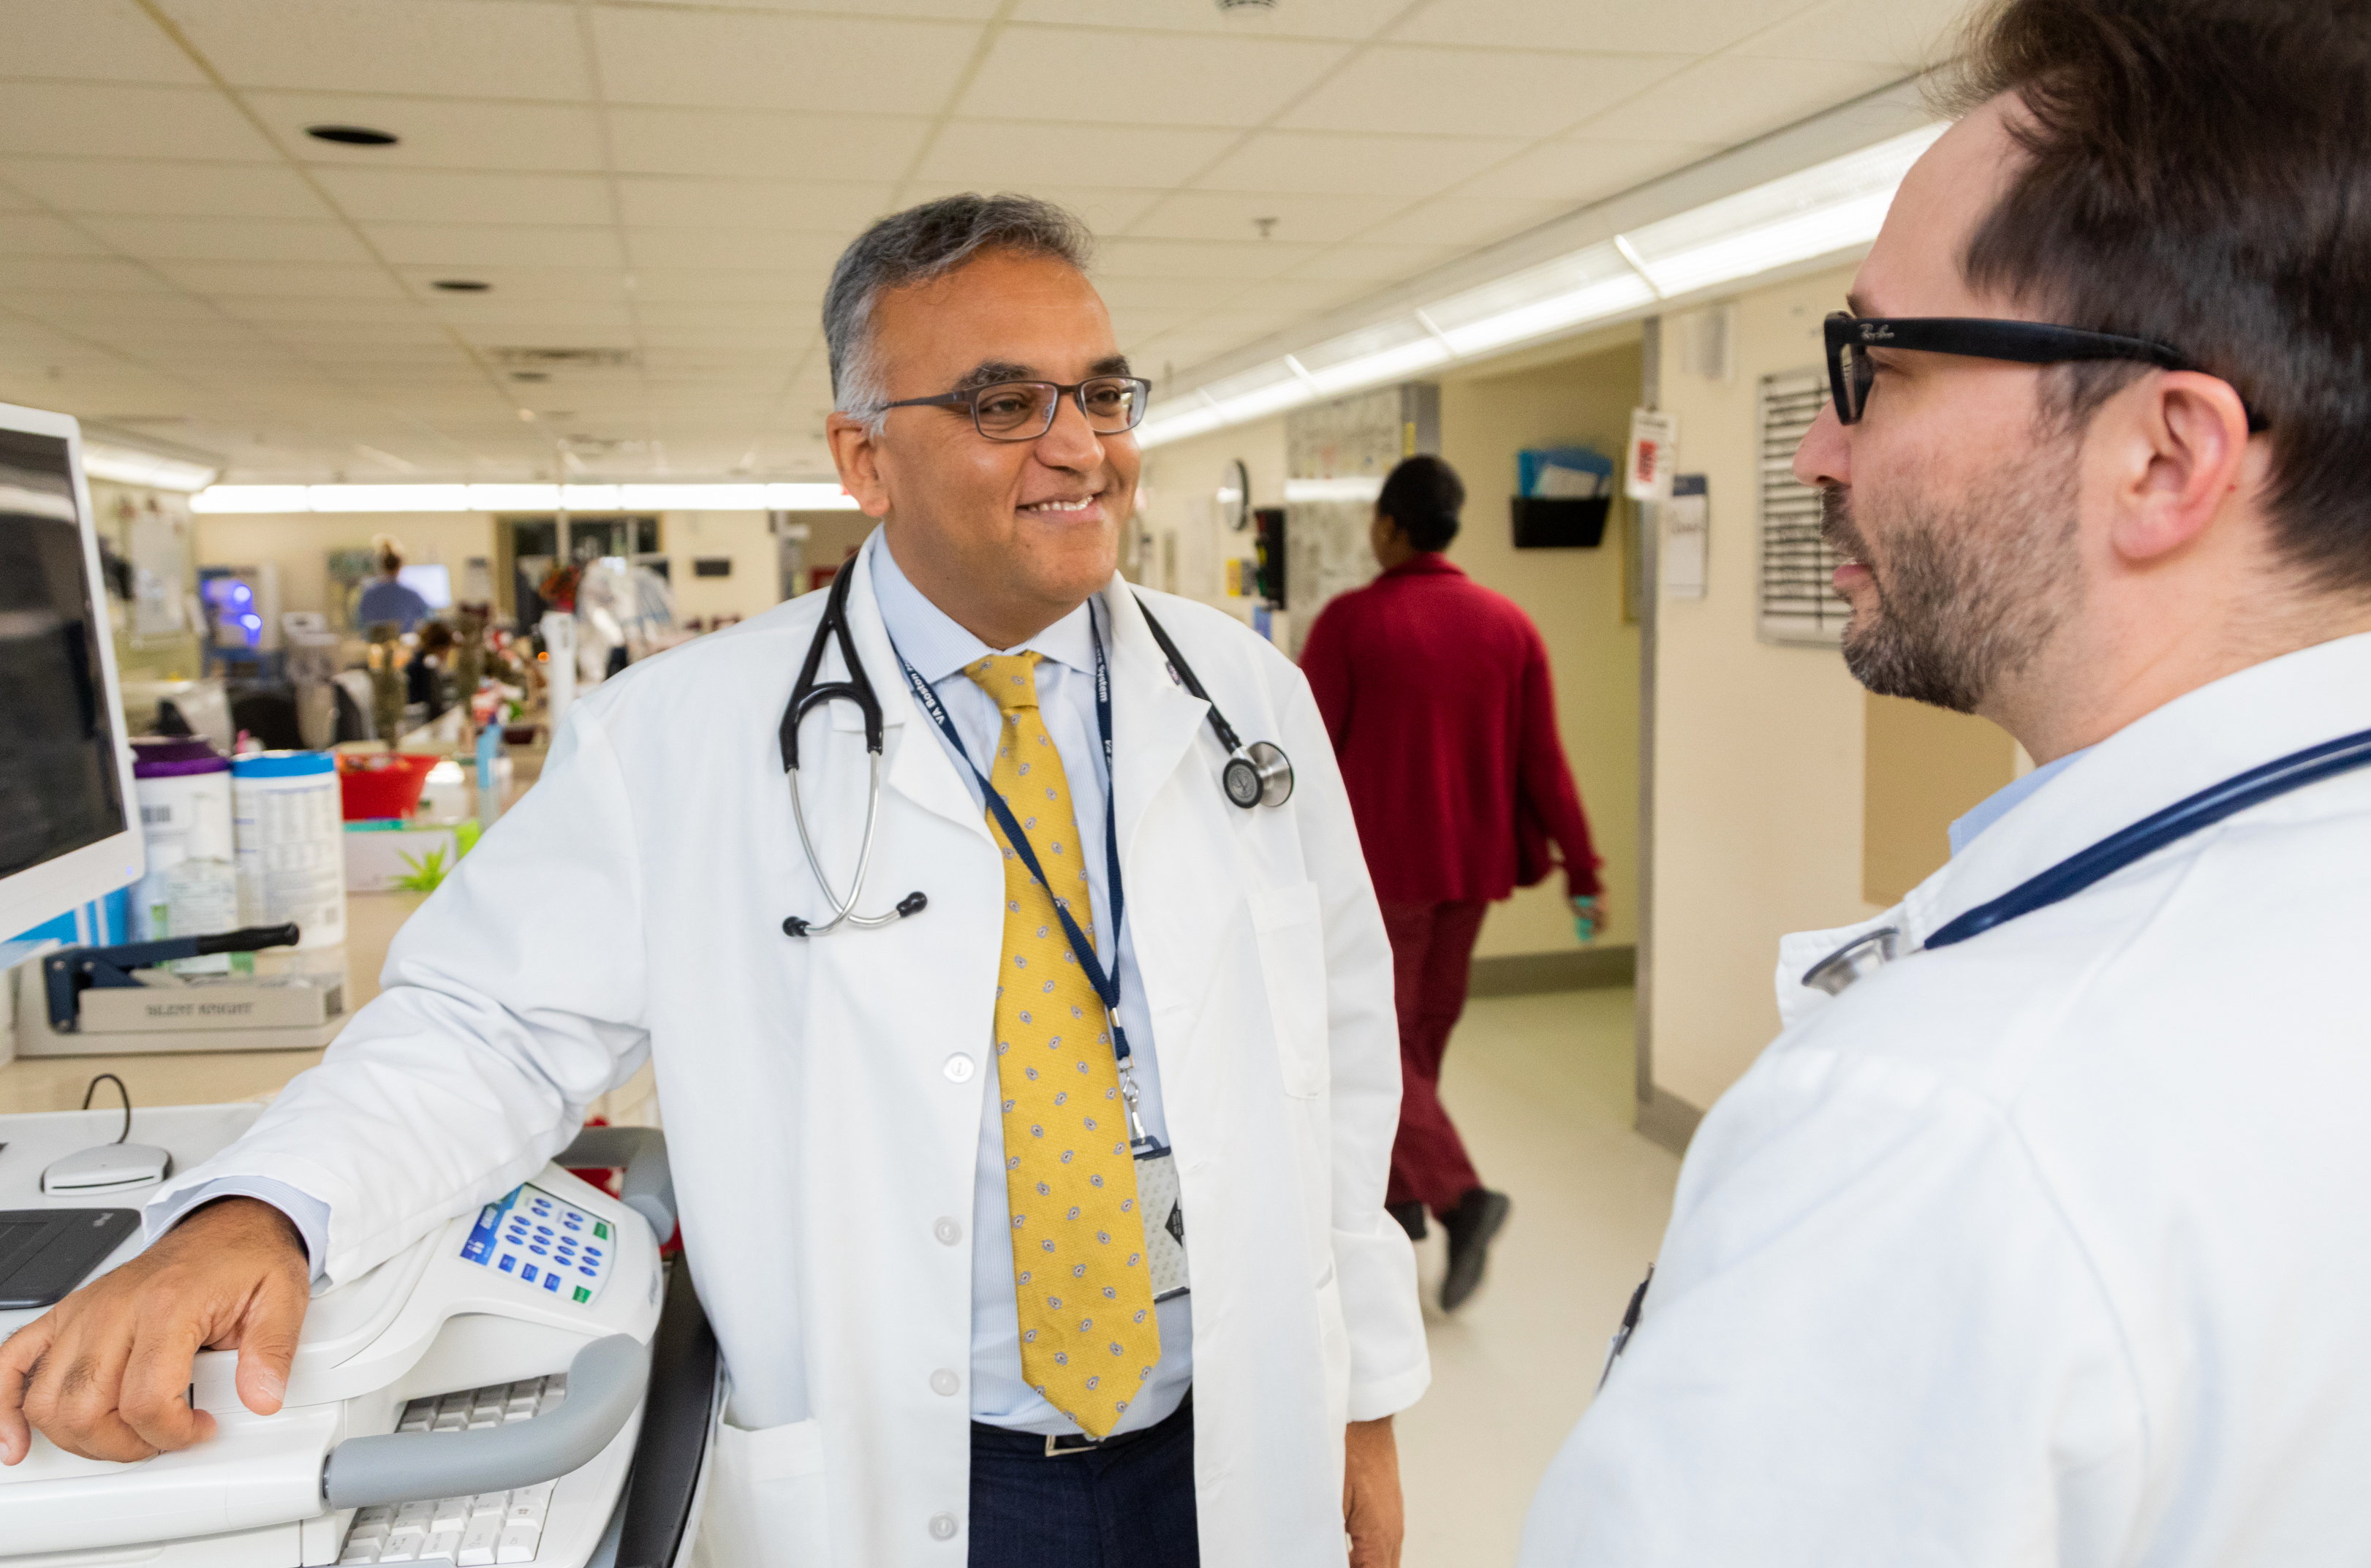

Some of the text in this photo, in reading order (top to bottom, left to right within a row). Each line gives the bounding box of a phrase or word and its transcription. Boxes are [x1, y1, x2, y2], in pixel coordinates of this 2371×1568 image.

[911, 673, 945, 726] VA Boston
[1098, 664, 1108, 703] System
